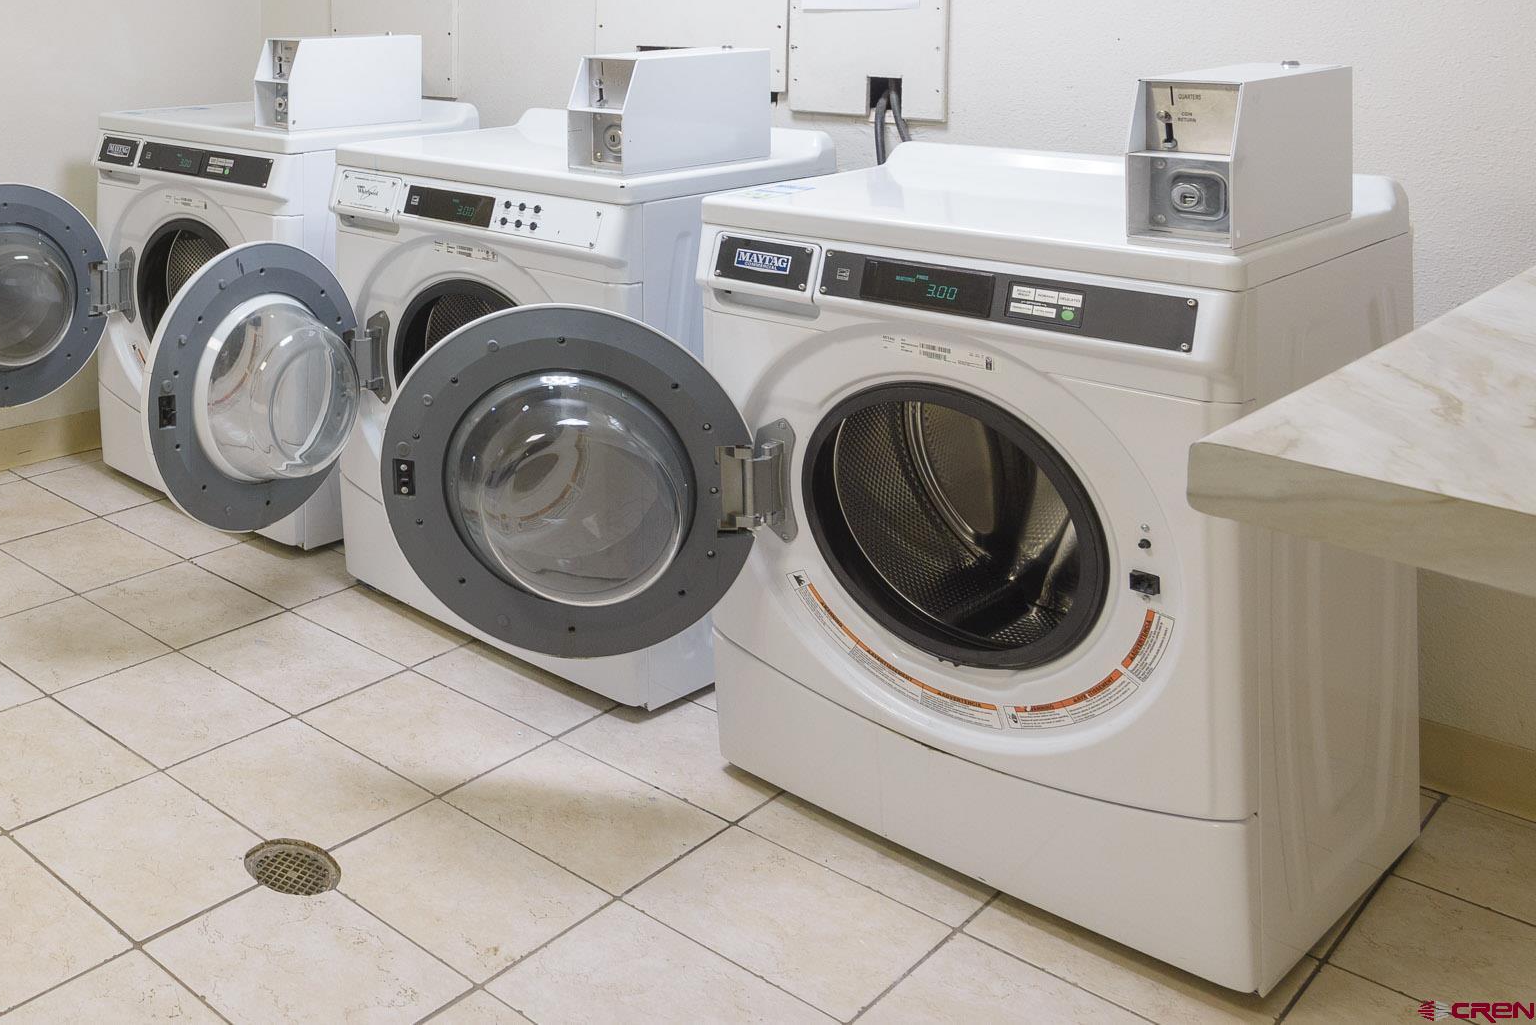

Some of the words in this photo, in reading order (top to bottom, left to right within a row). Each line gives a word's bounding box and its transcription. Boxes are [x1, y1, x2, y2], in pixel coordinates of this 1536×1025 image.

[1177, 93, 1202, 101] QUARTERS
[738, 251, 788, 268] MAYTAG
[926, 284, 958, 300] 3.00
[942, 692, 982, 709] ADVERTENCIA
